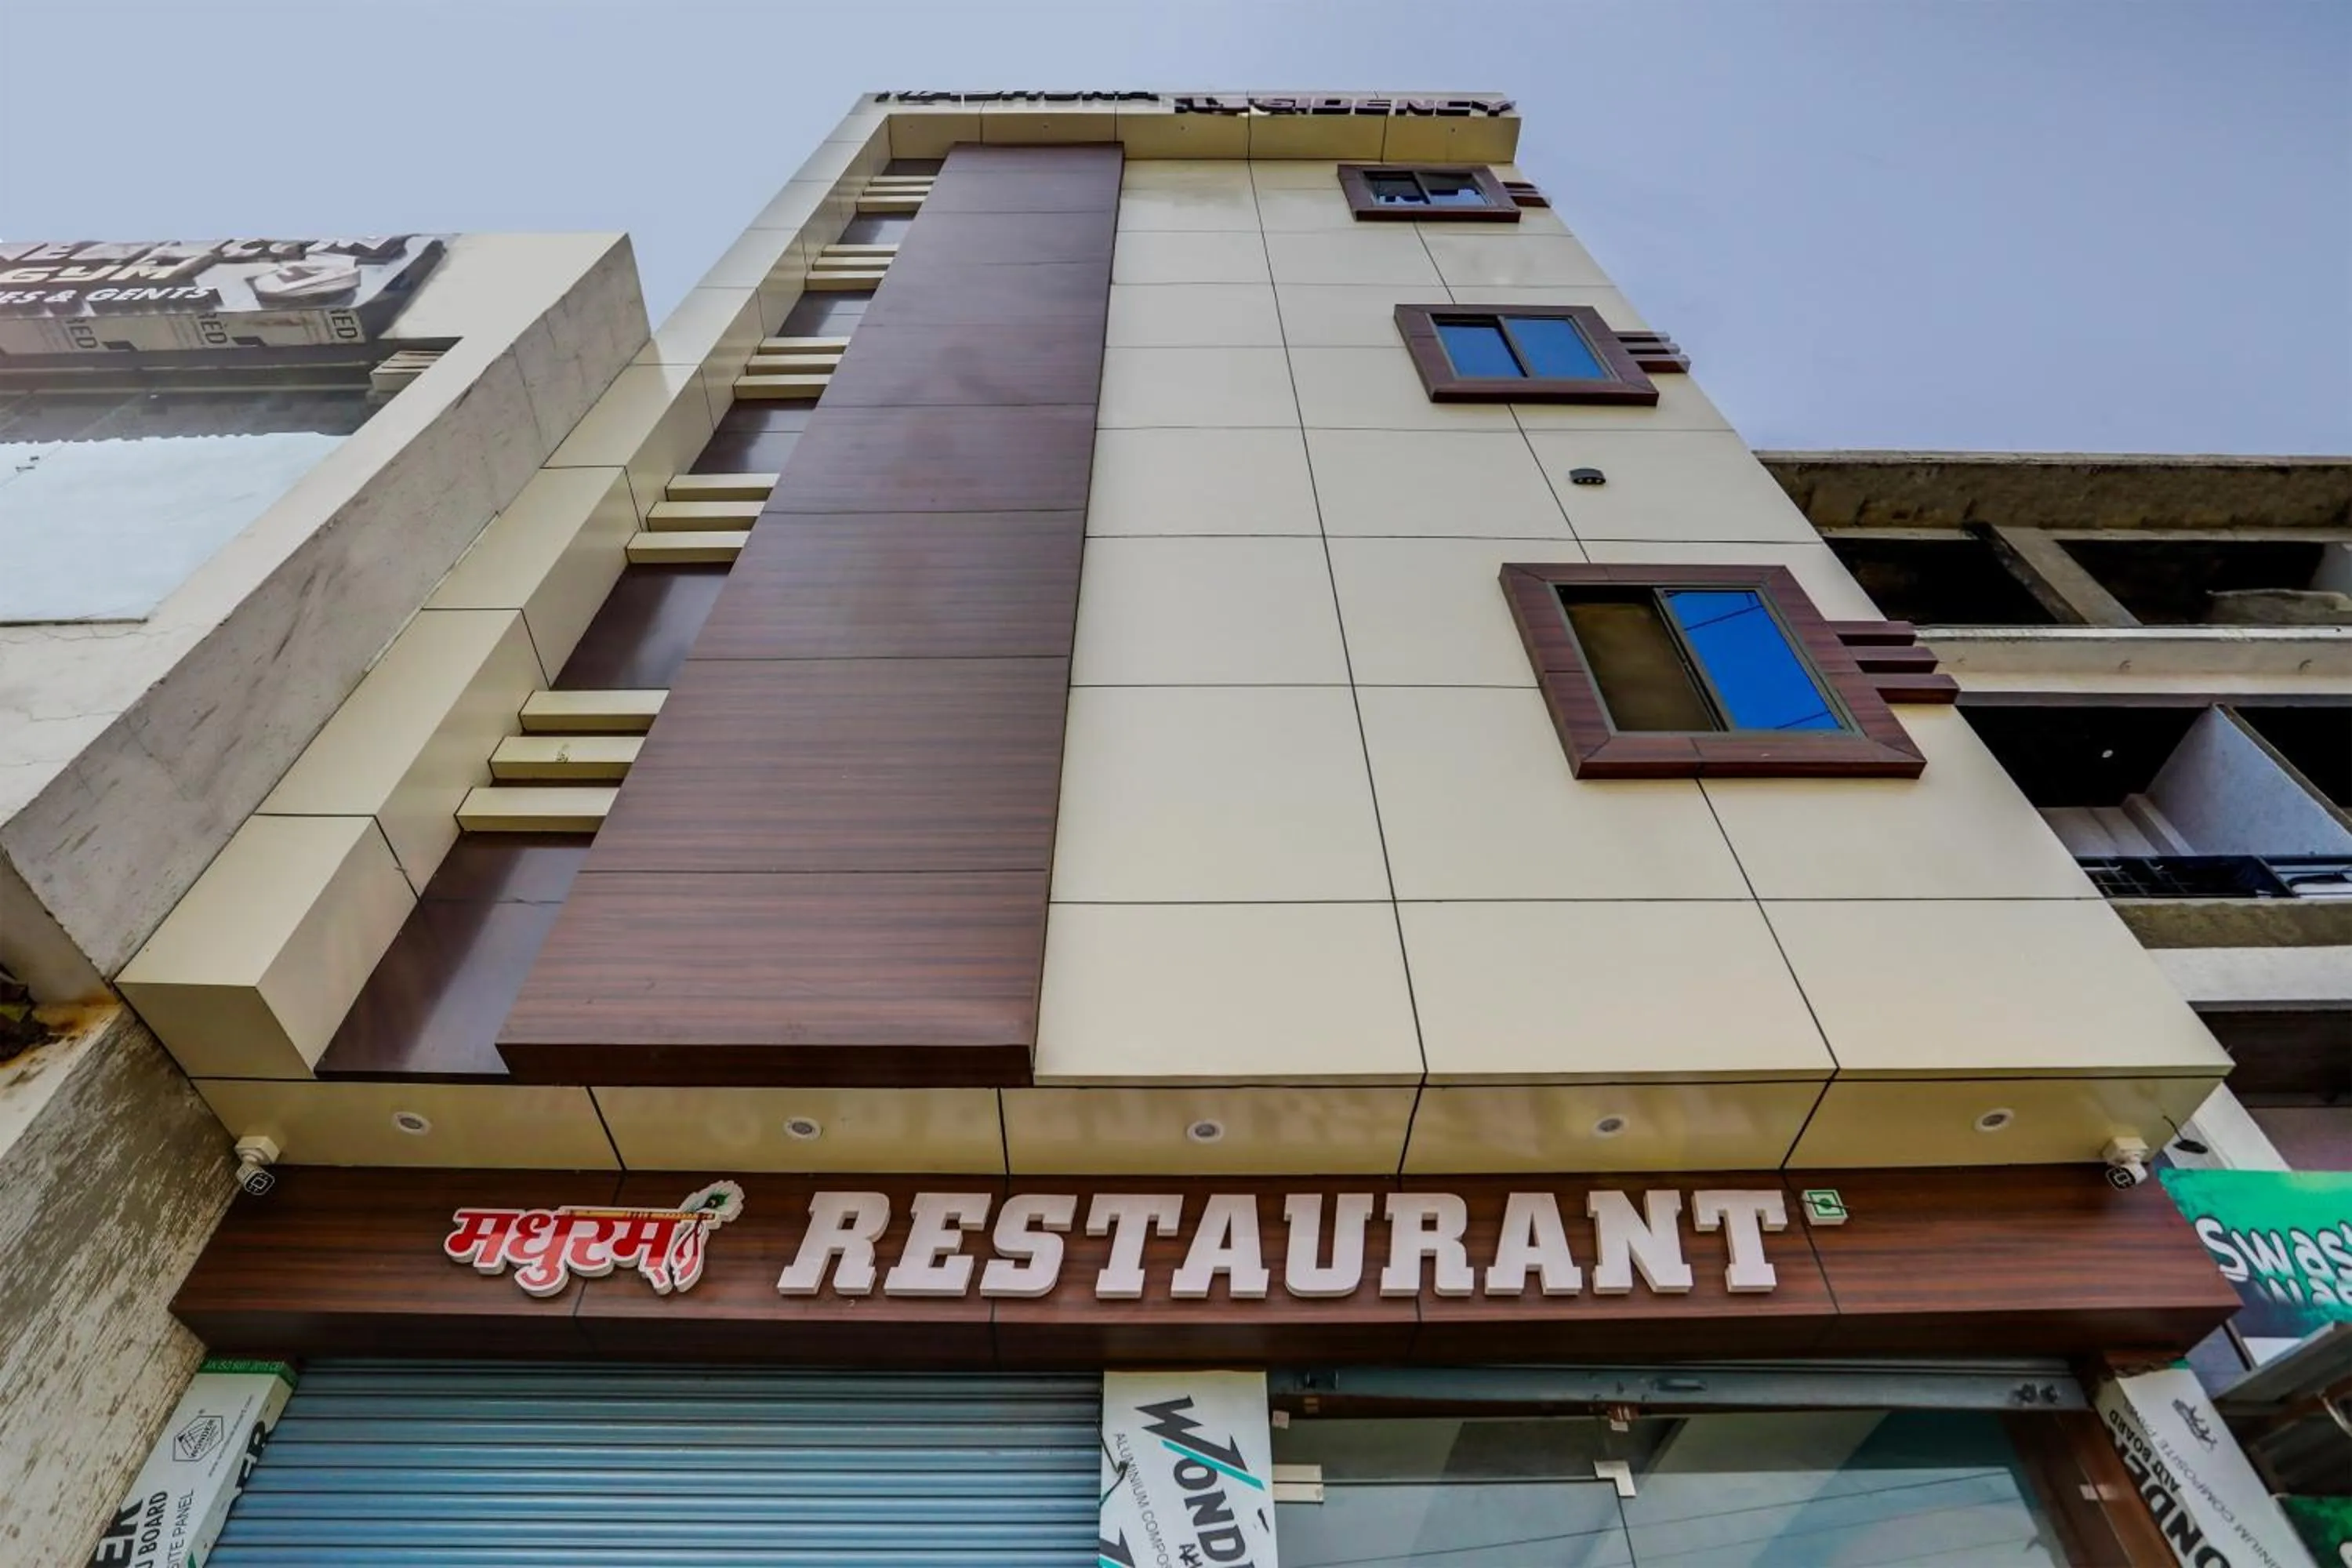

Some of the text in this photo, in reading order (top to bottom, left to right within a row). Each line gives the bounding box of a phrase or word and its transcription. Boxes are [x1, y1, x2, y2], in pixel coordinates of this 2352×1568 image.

[85, 286, 212, 303] GENTS
[776, 1189, 1788, 1298] RESTAURANT
[137, 1490, 169, 1556] BOARD
[172, 1490, 194, 1538] PANEL
